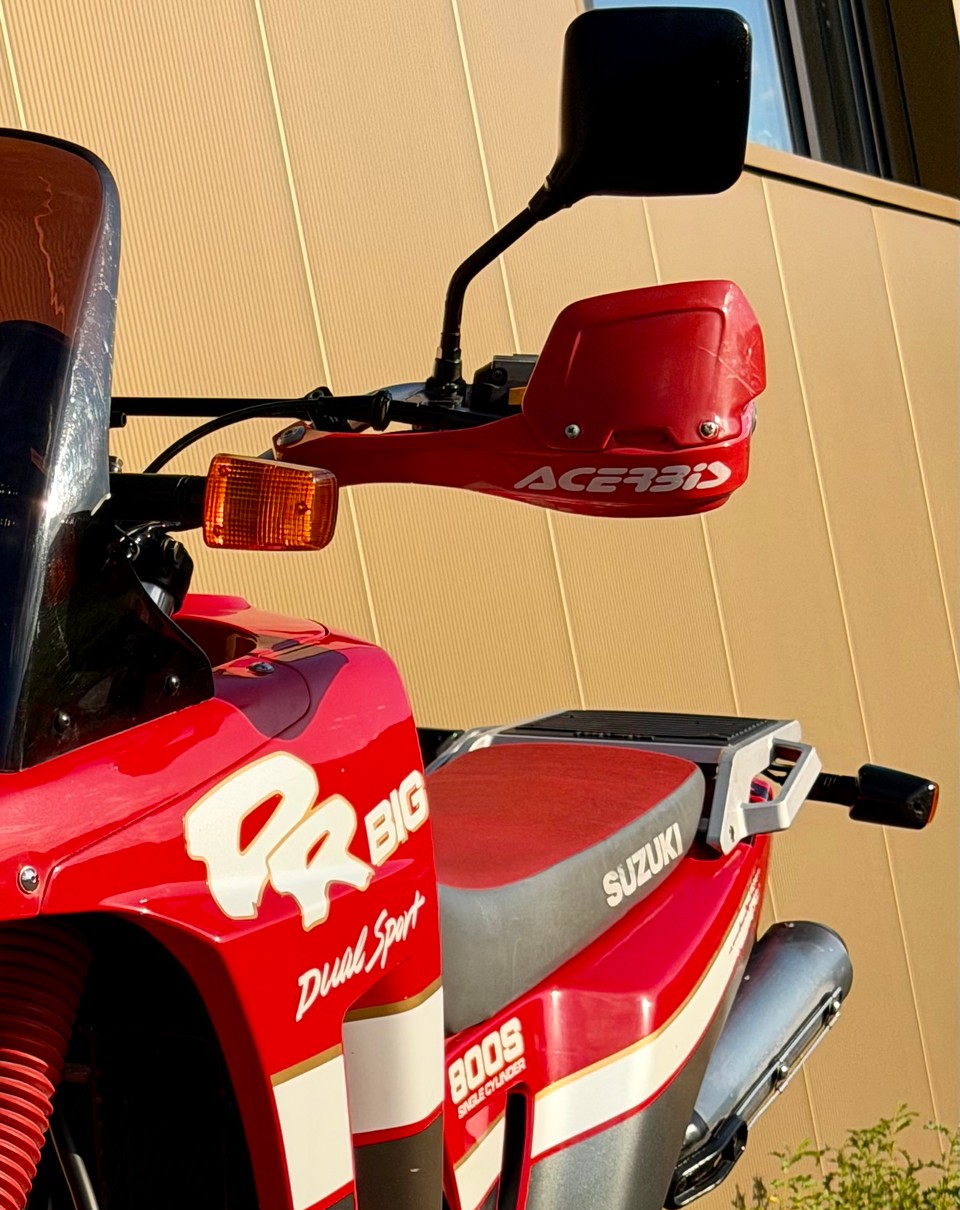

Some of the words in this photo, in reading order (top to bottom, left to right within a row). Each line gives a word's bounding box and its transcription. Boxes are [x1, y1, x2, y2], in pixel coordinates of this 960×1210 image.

[364, 770, 430, 867] BIG
[602, 822, 683, 908] SUZUKI
[296, 925, 369, 1022] Dual
[365, 890, 426, 975] Sport
[448, 1016, 525, 1105] 800S
[457, 1086, 487, 1120] SINGLE
[484, 1056, 527, 1097] CYLINDER
